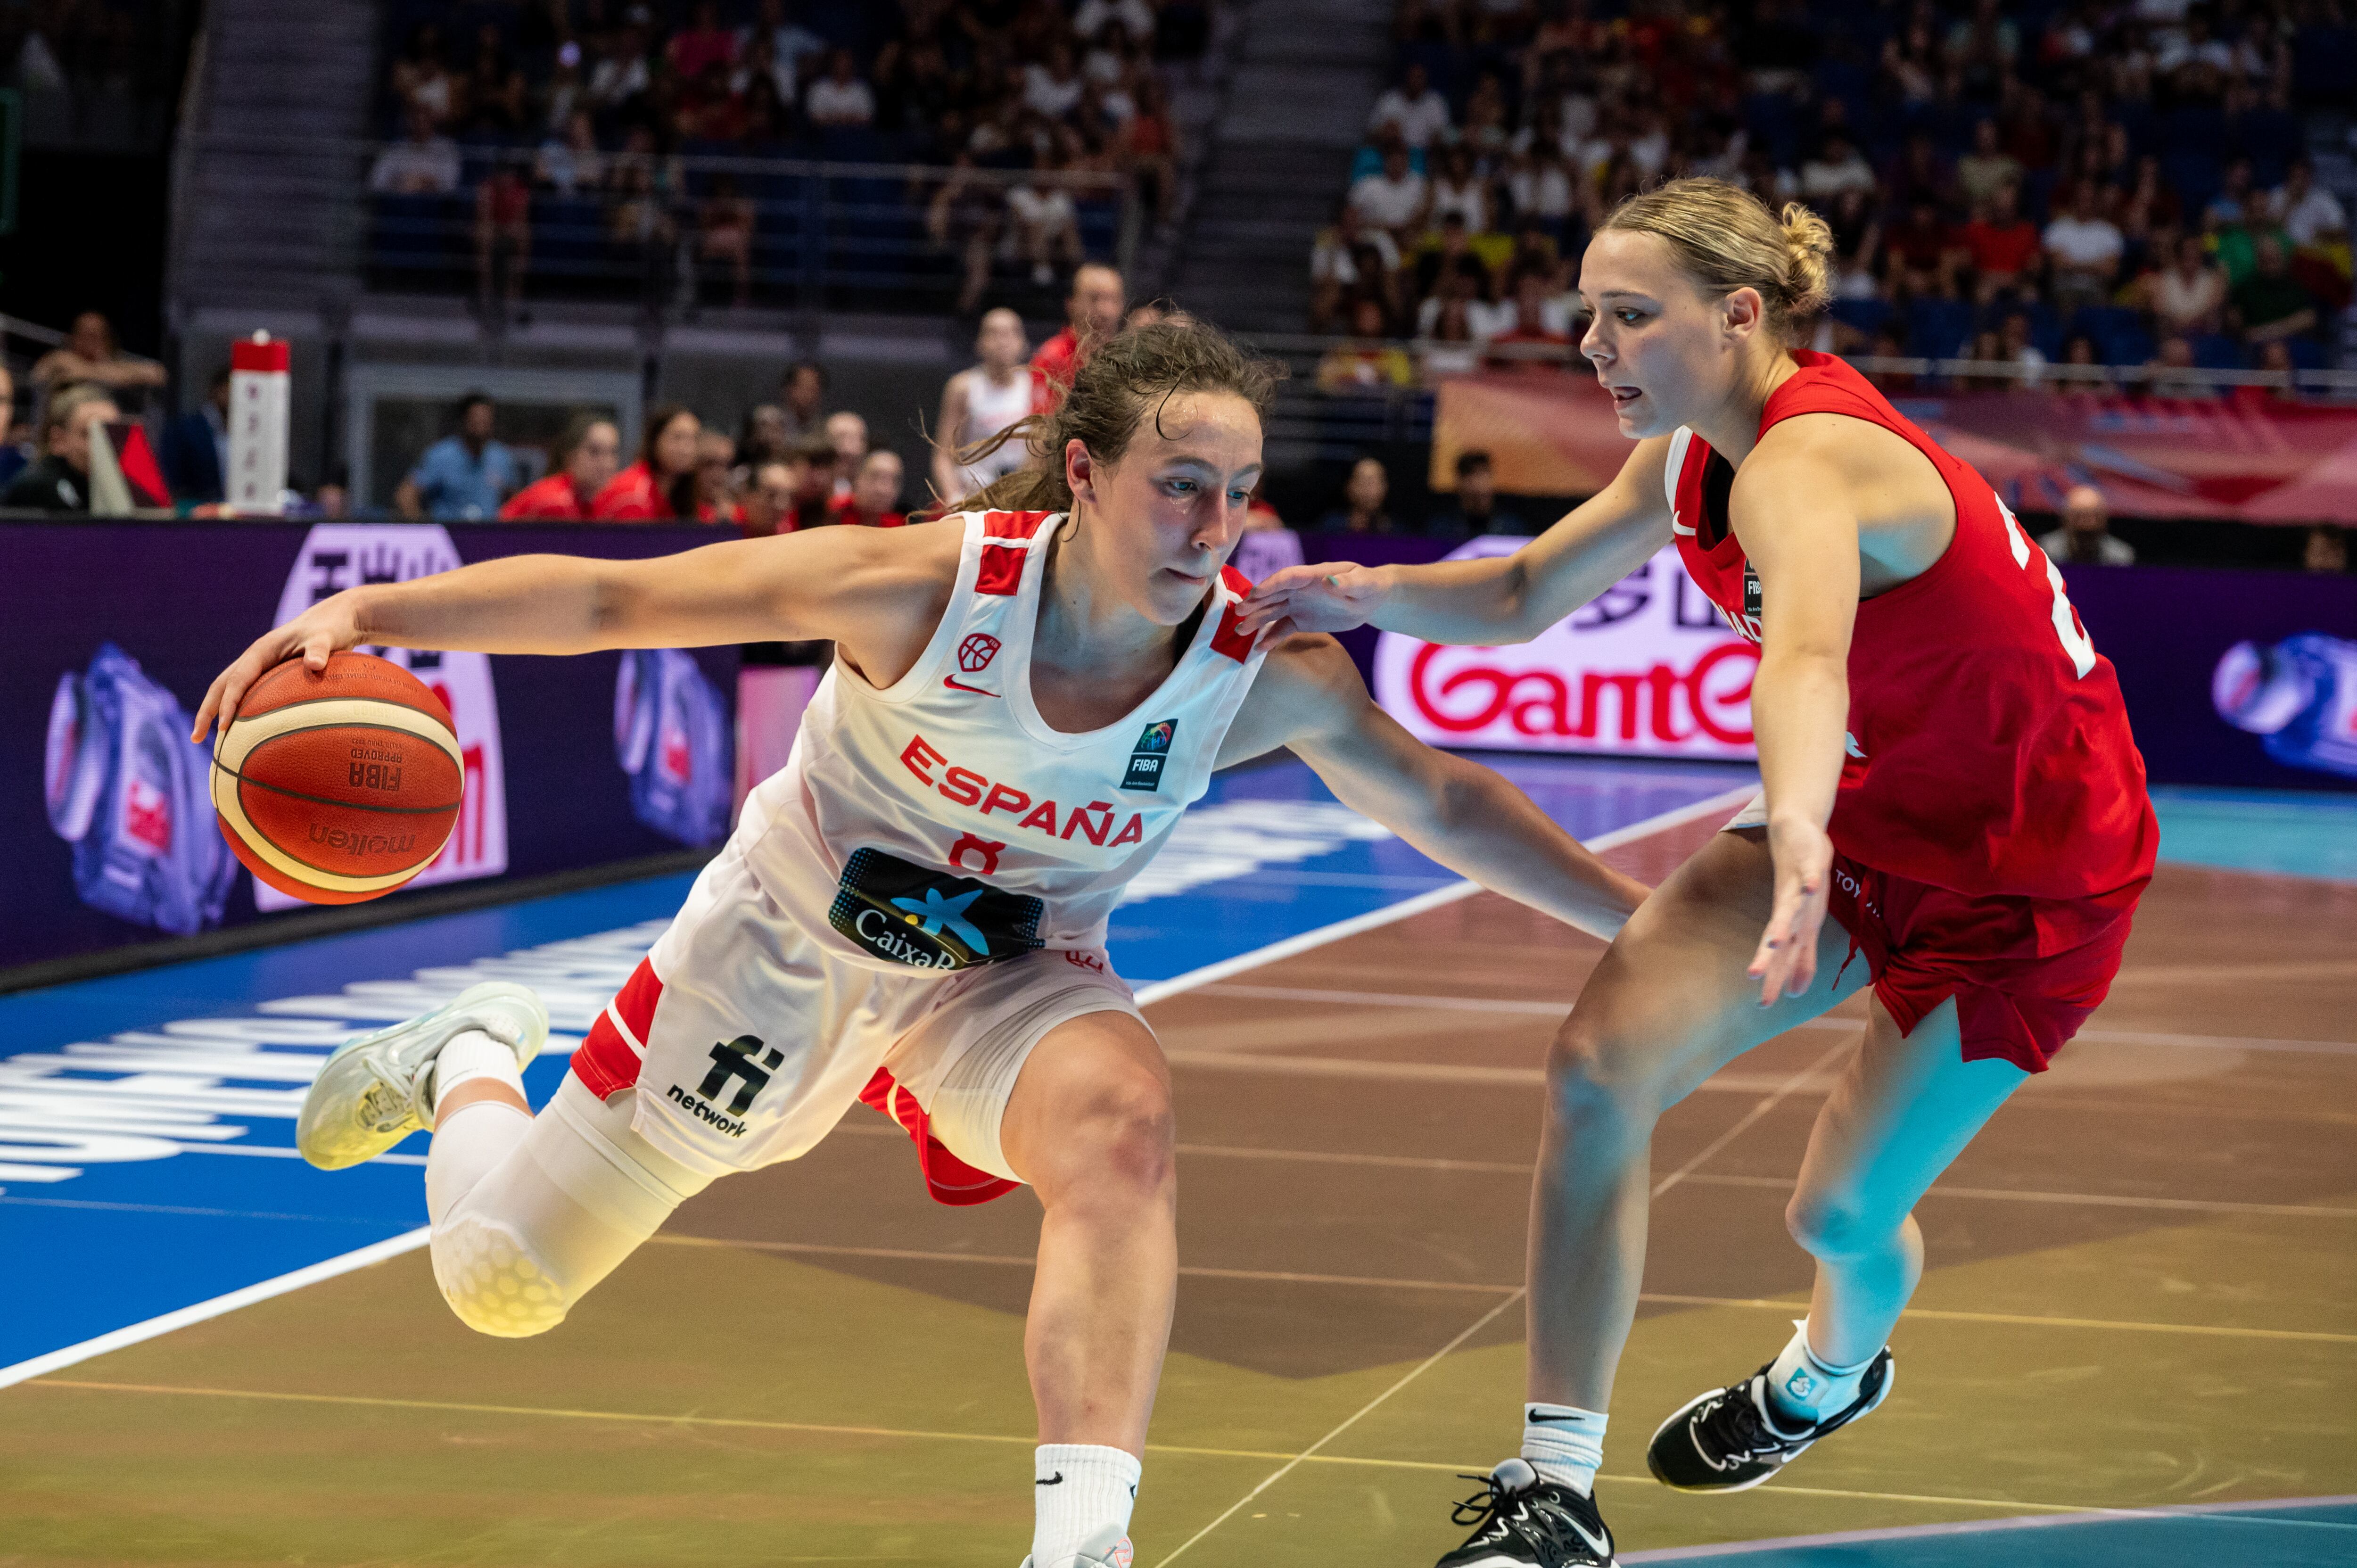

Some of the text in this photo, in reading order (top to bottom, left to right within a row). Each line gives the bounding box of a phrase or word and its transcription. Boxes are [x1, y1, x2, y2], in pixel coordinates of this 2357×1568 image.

[350, 749, 402, 763] APPROVED
[1132, 759, 1159, 772] FIBA
[349, 762, 401, 792] FIBA
[900, 734, 1143, 847] ESPAÑA
[308, 823, 416, 857] molten
[666, 1084, 748, 1138] network
